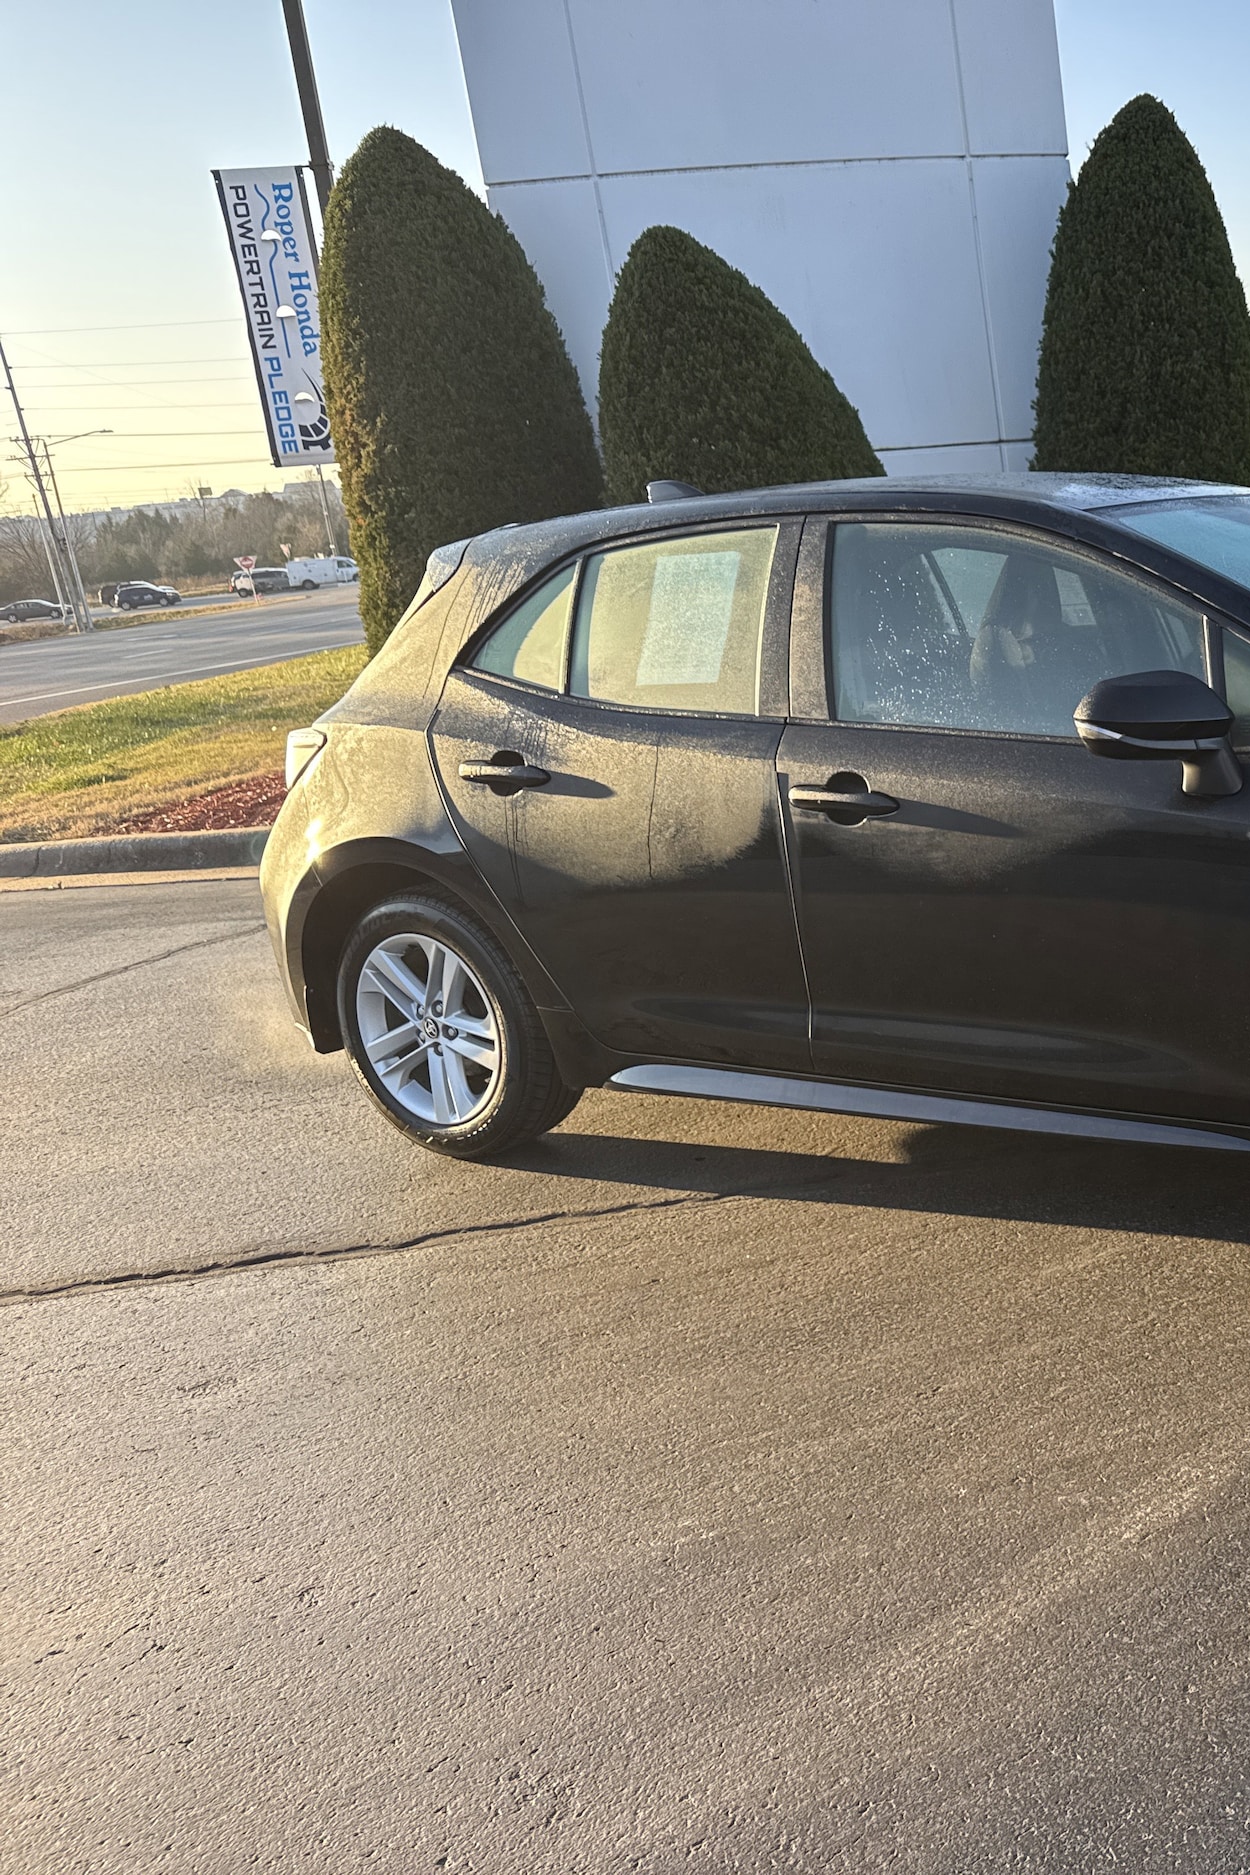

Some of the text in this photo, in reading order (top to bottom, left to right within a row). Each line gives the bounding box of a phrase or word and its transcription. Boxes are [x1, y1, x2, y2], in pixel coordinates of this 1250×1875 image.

[229, 185, 299, 454] POWERTRAIN PLEDGE
[272, 182, 321, 357] Roper Honda
